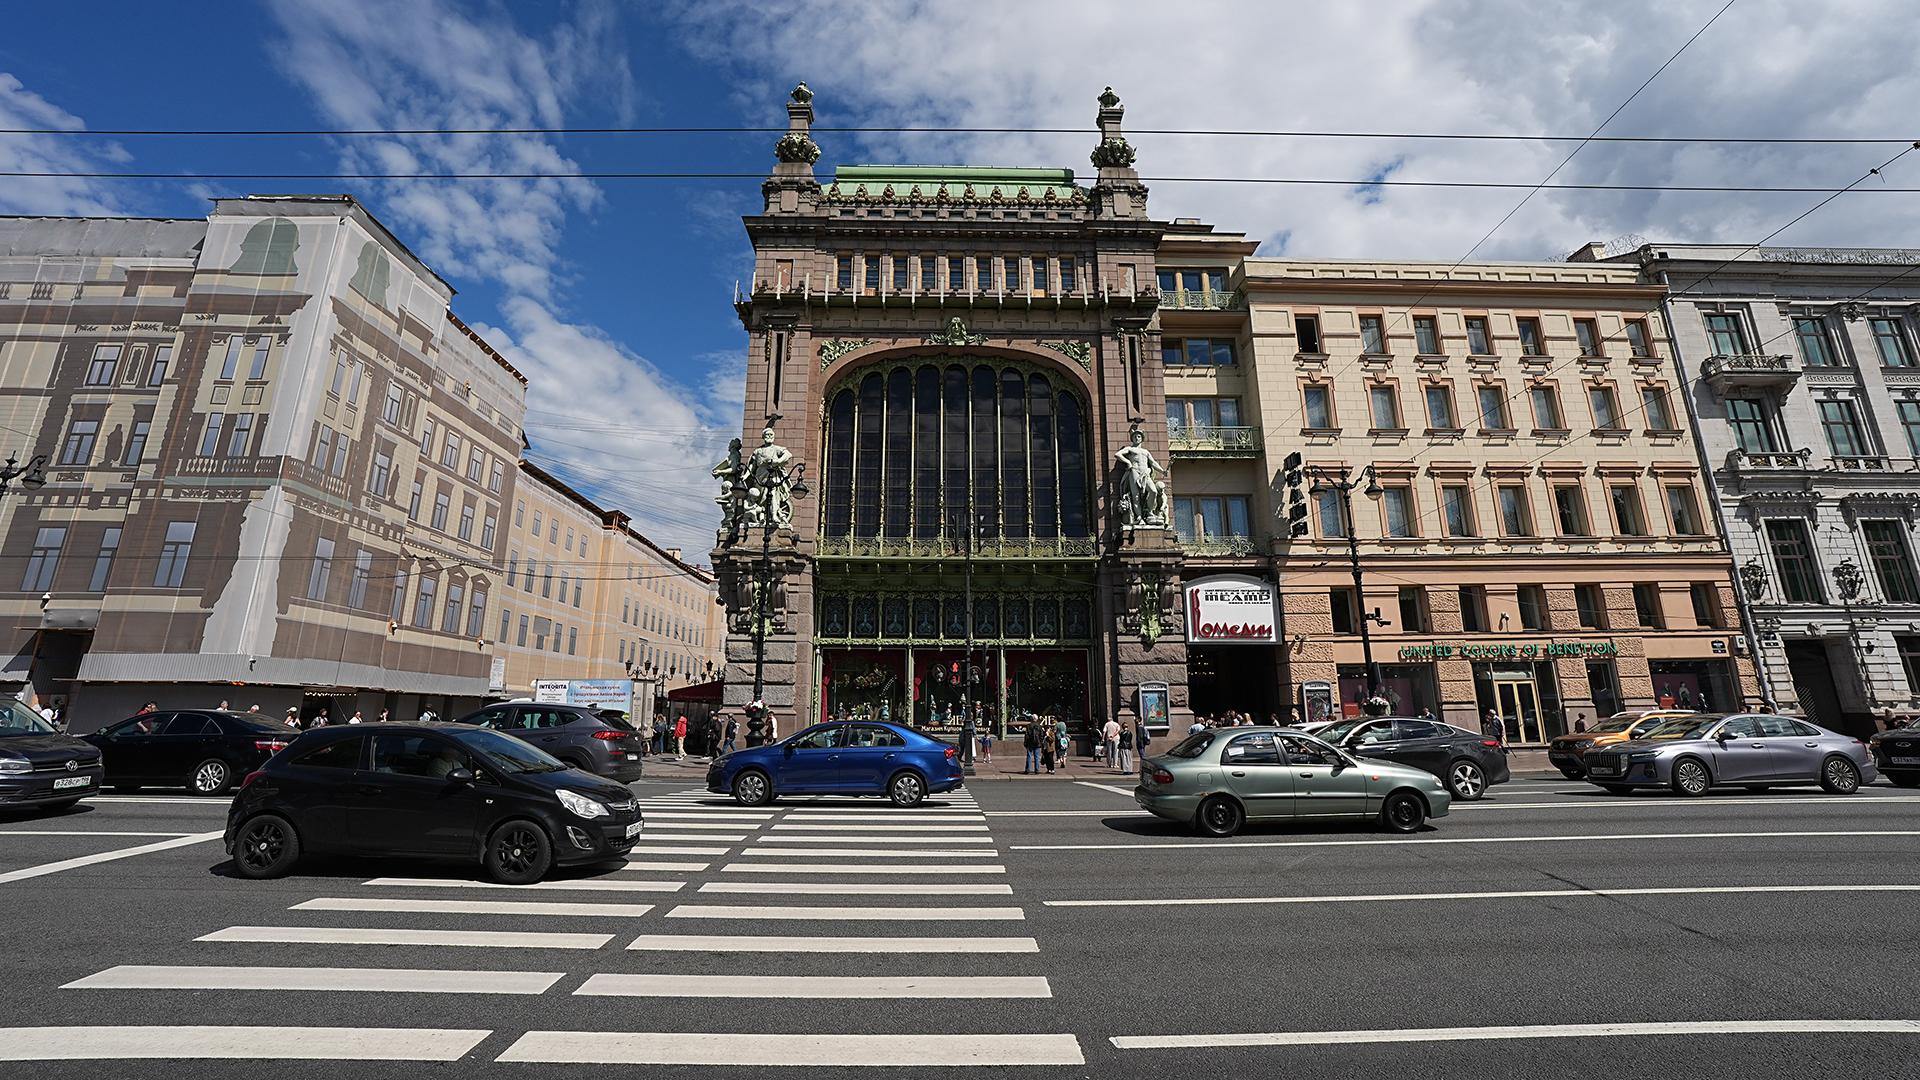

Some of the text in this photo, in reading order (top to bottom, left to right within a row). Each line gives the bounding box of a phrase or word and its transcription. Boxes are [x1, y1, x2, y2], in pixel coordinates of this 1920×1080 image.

[1401, 642, 1617, 657] UNITED COLORS OF BENETTON
